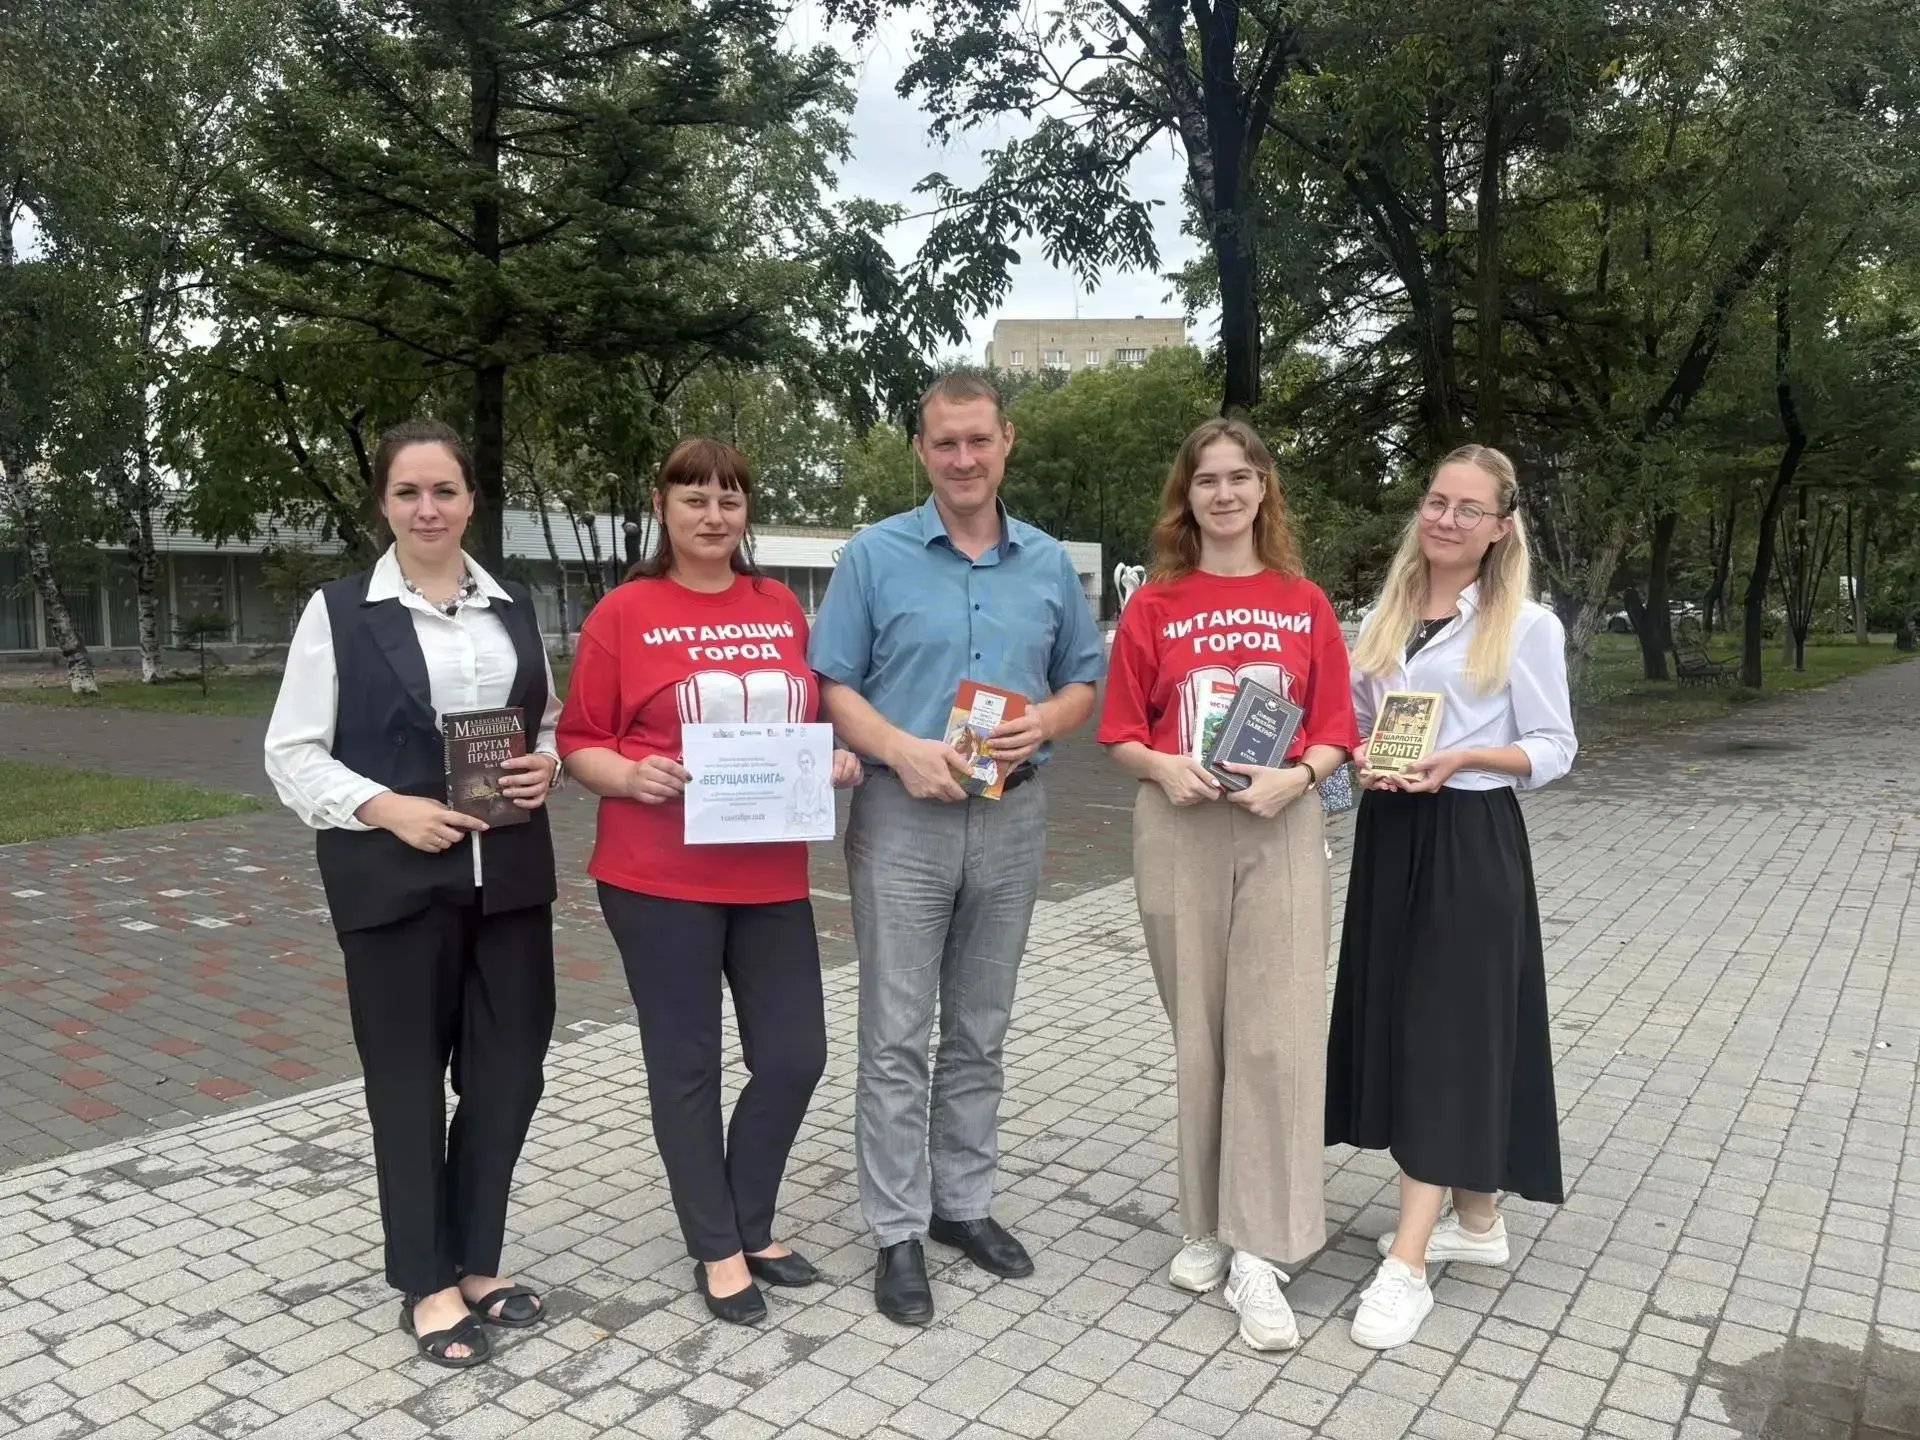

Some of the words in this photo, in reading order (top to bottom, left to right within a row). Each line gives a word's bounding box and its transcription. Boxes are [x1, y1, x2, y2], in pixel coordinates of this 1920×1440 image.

[1163, 608, 1311, 639] ЧИТАЮЩИЙ
[643, 621, 794, 645] ЧИТАЮЩИЙ
[1193, 631, 1282, 653] ГОРОД
[687, 643, 782, 661] ГОРОД
[454, 715, 522, 739] МАРИНИНА
[470, 716, 512, 726] АЛЕКСАНДРА
[468, 738, 510, 753] ДРУГАЯ
[1383, 734, 1422, 742] ШАРЛОТТА
[468, 749, 513, 764] ПРАВДА
[1371, 742, 1421, 758] БРОНТЕ
[699, 773, 749, 787] «БЕГУЩАЯ
[750, 772, 786, 785] КНИГА»
